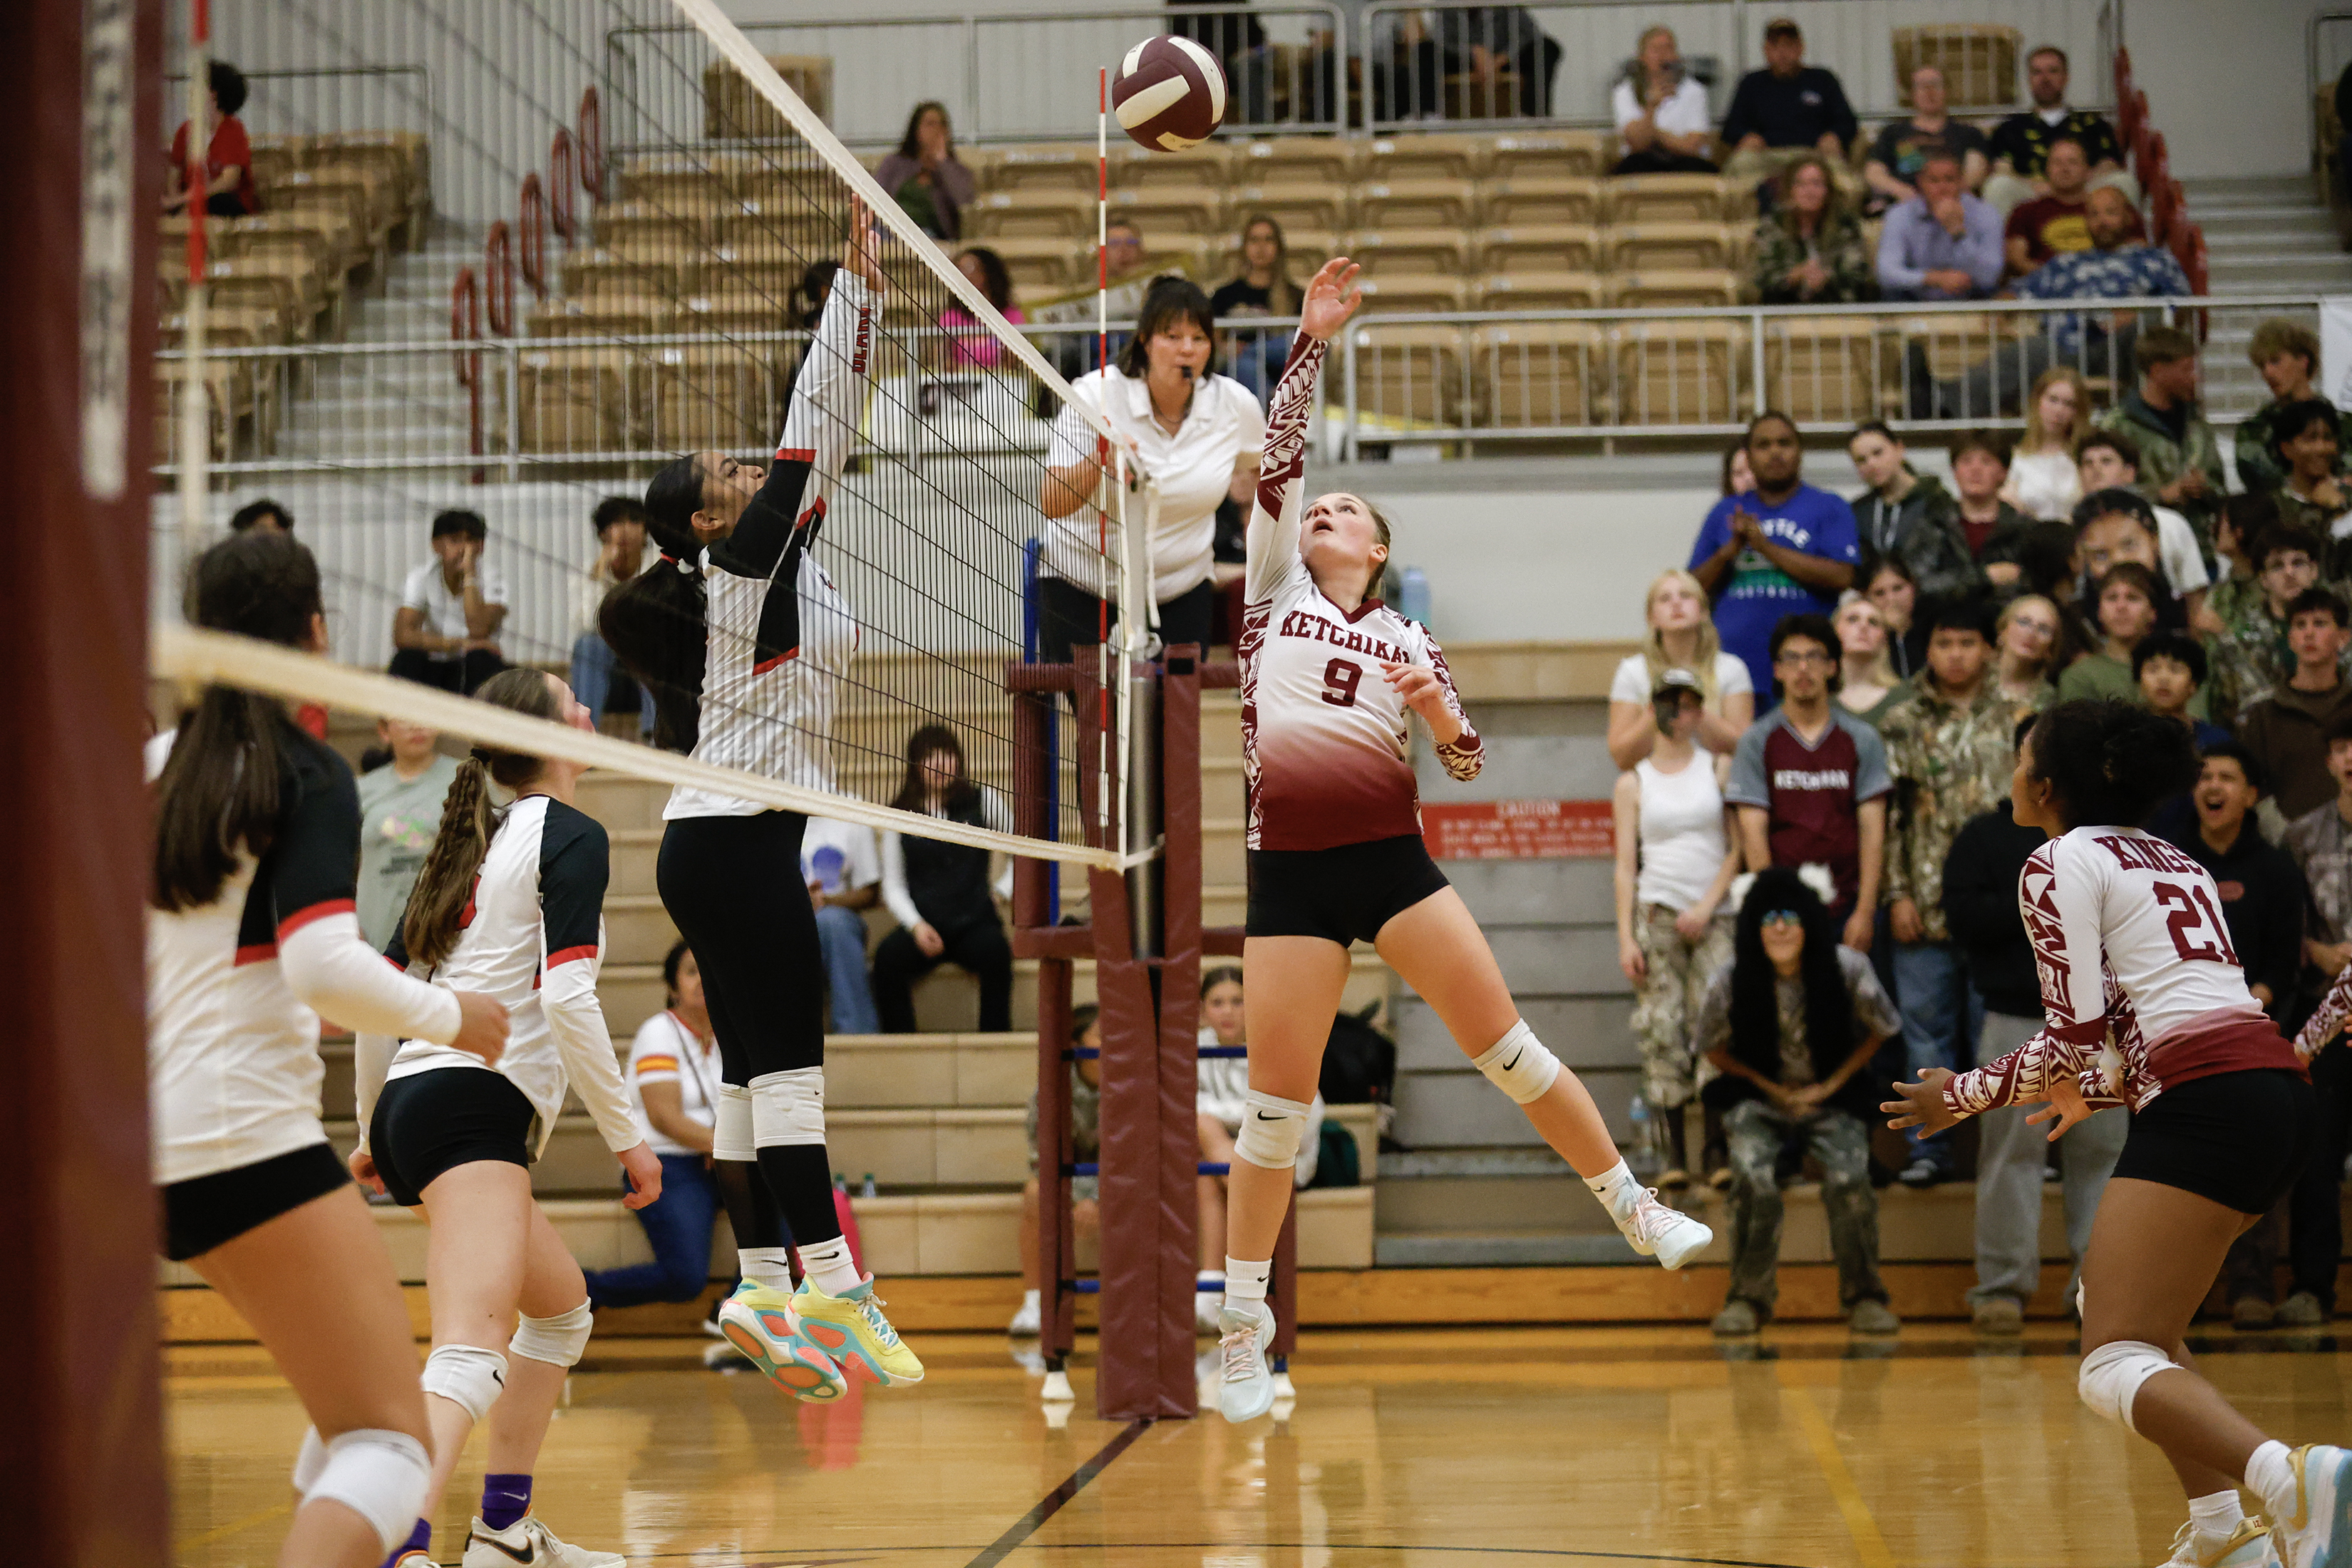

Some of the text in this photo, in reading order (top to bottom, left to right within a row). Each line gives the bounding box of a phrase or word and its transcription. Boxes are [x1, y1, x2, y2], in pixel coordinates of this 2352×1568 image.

[1321, 657, 1363, 707] 9
[2092, 835, 2203, 876] KINGS
[2152, 881, 2244, 968] 21
